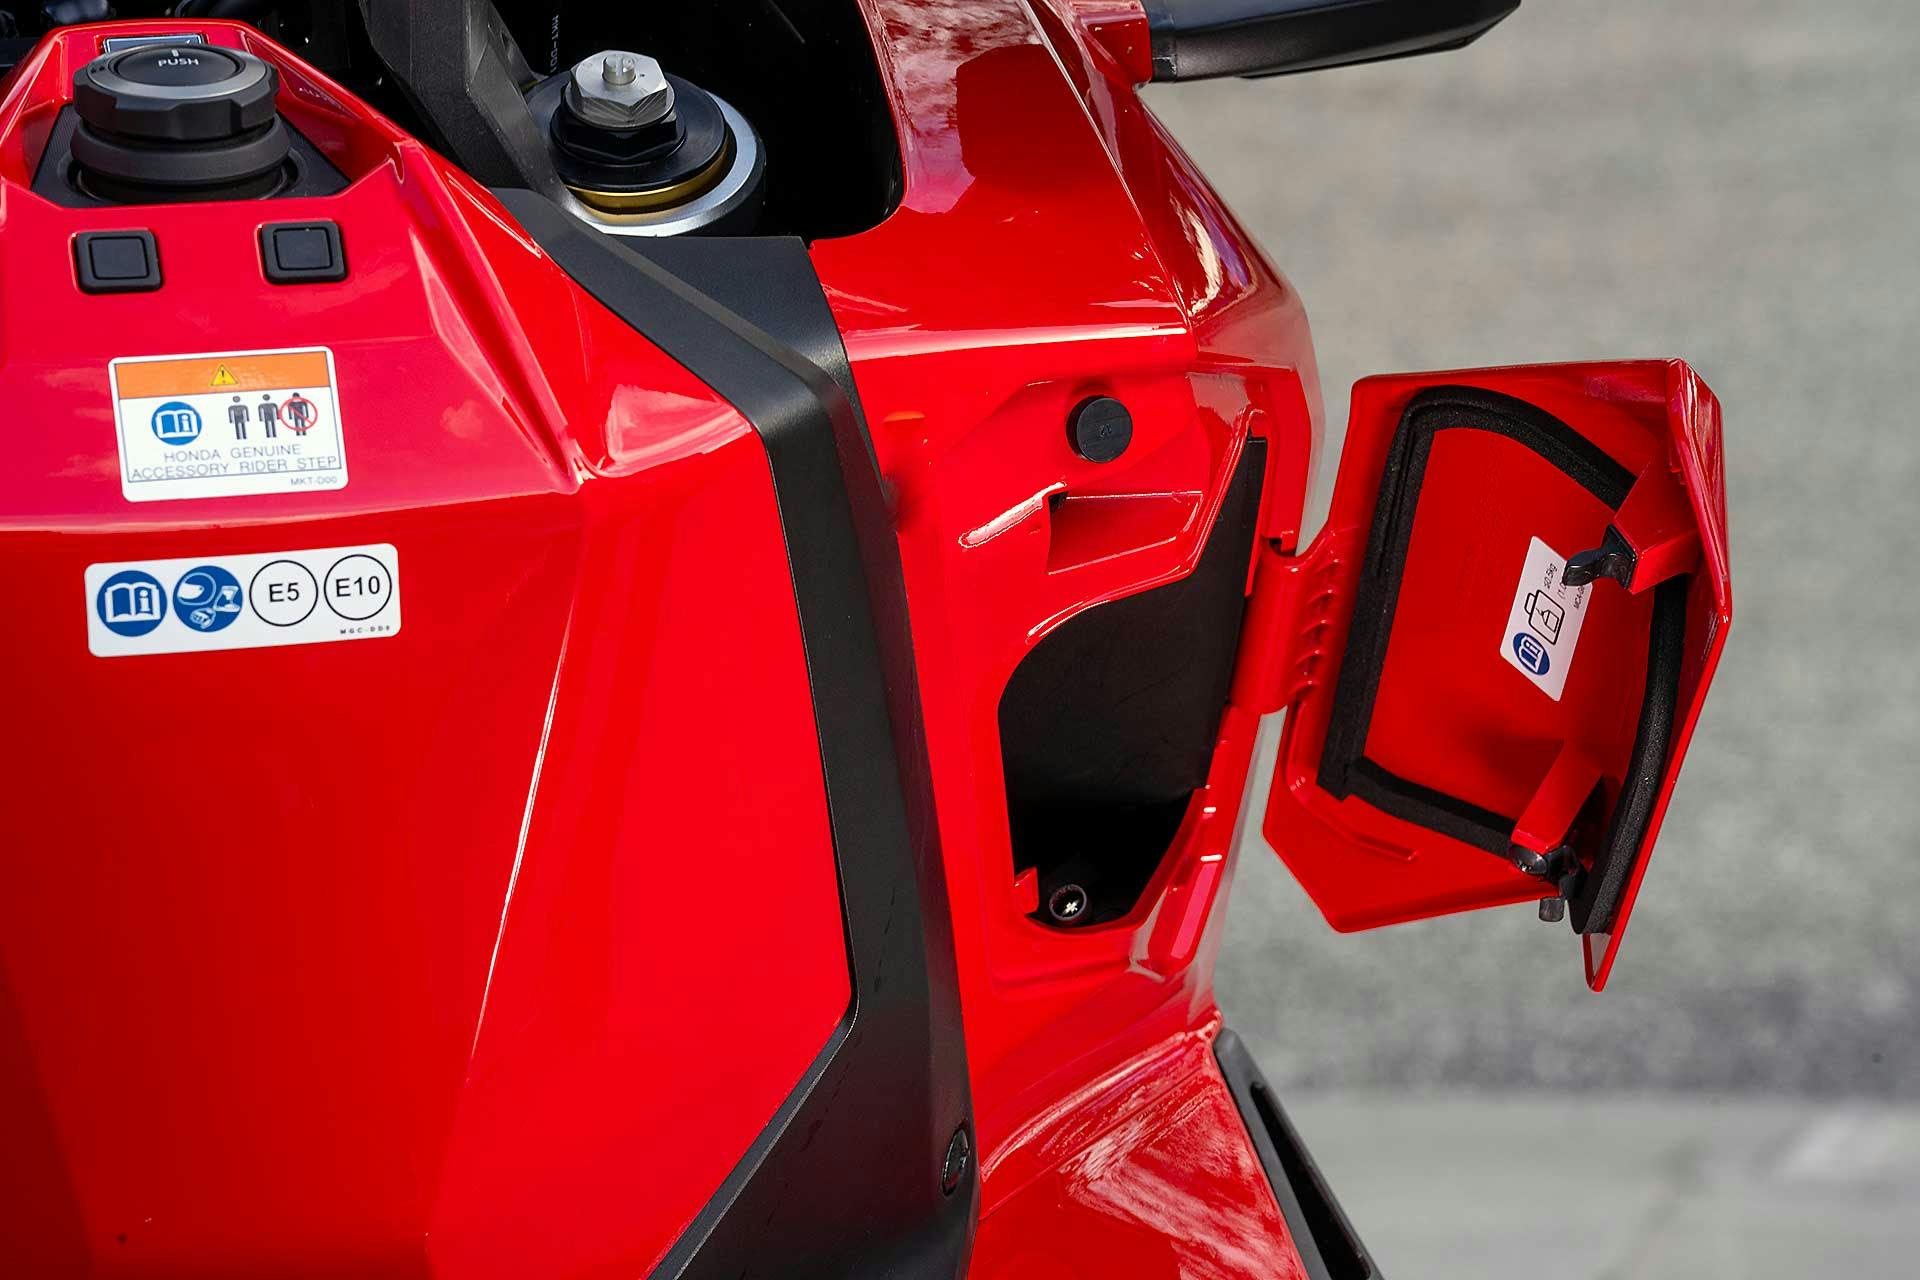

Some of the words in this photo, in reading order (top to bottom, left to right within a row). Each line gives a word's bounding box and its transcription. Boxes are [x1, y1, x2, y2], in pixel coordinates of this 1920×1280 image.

[158, 58, 199, 67] PUSH
[164, 448, 222, 463] HONDA
[230, 443, 302, 459] GENUINE
[131, 463, 229, 480] ACCESSORY
[239, 458, 288, 472] RIDER
[297, 455, 338, 469] STEP
[268, 582, 300, 603] E5
[335, 575, 381, 598] E10
